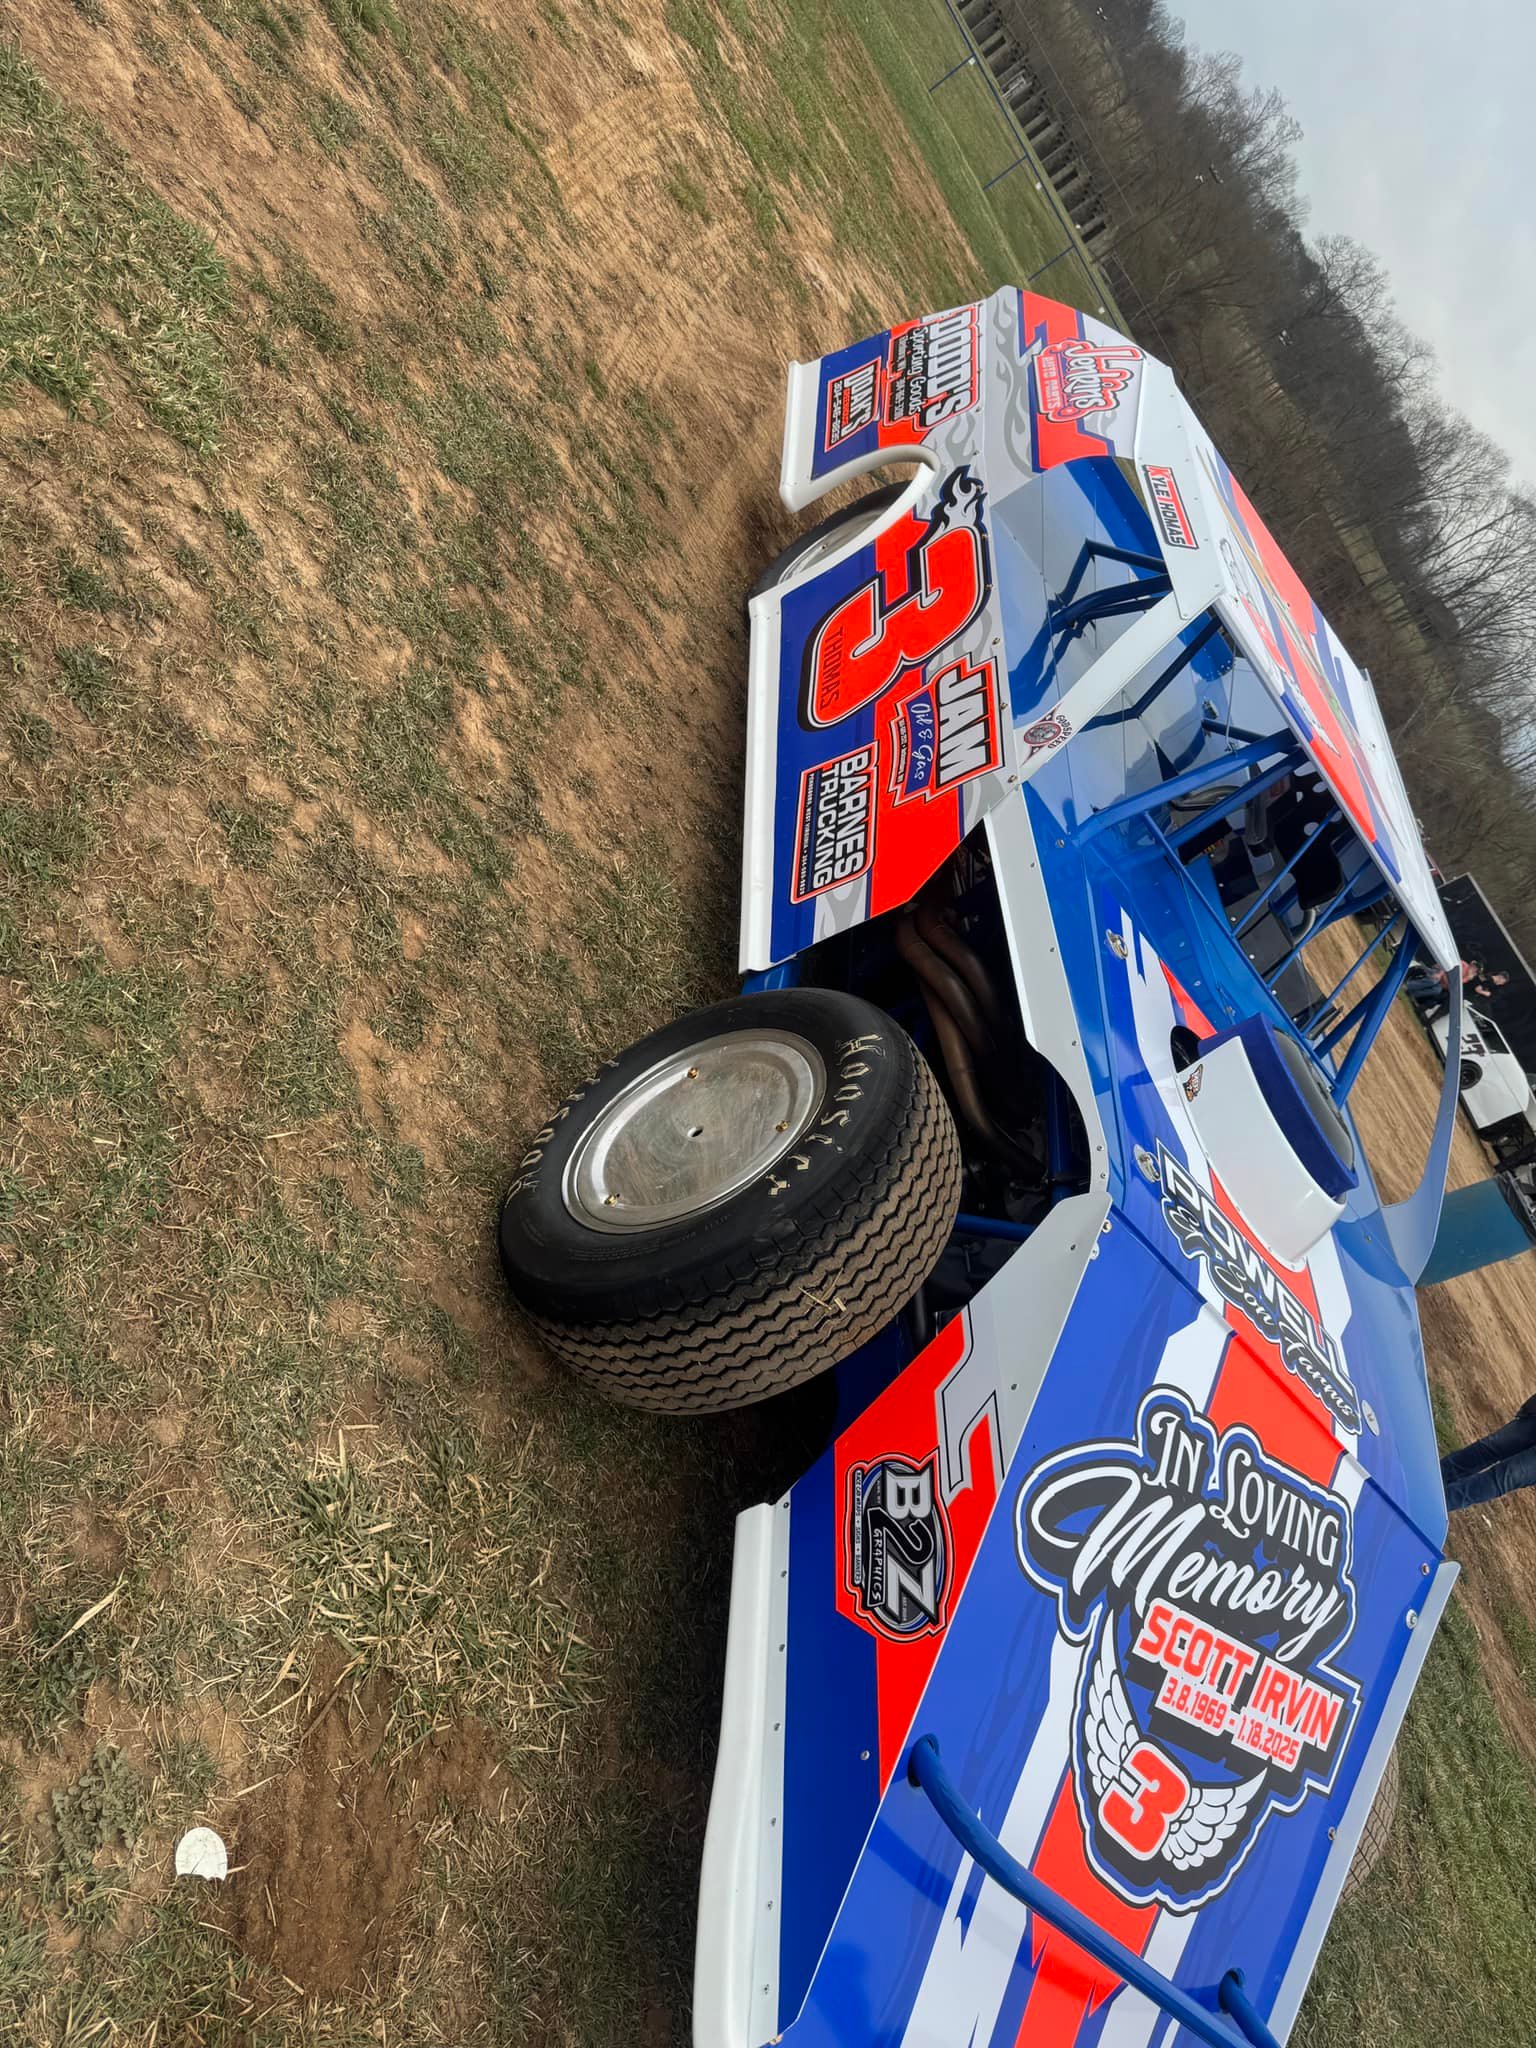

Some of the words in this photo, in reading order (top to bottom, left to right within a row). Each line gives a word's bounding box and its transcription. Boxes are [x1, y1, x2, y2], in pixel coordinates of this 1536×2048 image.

[907, 327, 929, 375] Sporting
[925, 310, 971, 426] DODD'S
[1041, 356, 1057, 381] AUTO
[1044, 379, 1061, 410] PARTS
[1065, 346, 1133, 410] Jenkins
[841, 364, 875, 437] DOAK'S
[909, 376, 927, 416] Goods
[1147, 465, 1170, 498] KYLE
[1158, 490, 1192, 546] THOMAS
[810, 525, 982, 727] 3
[820, 626, 844, 711] THOMAS
[911, 703, 931, 726] Oil
[918, 727, 933, 741] &
[939, 668, 991, 785] JAM
[912, 744, 933, 781] Gas
[813, 762, 839, 888] TRUCKING
[834, 751, 870, 881] BARNES
[1163, 1153, 1354, 1399] POWELL
[1214, 1259, 1274, 1327] Son
[1279, 1320, 1357, 1419] Farms
[1143, 1410, 1204, 1493] IN
[1209, 1448, 1340, 1567] LOVING
[867, 1464, 936, 1622] B2Z
[871, 1528, 883, 1602] GRAPHICS
[1031, 1466, 1346, 1662] Memory
[1138, 1604, 1255, 1696] SCOTT
[1251, 1664, 1339, 1744] IRVIN
[1161, 1676, 1228, 1730] 3.8.1969
[1235, 1713, 1301, 1767] 1.18.2025
[1102, 1748, 1188, 1854] 3
